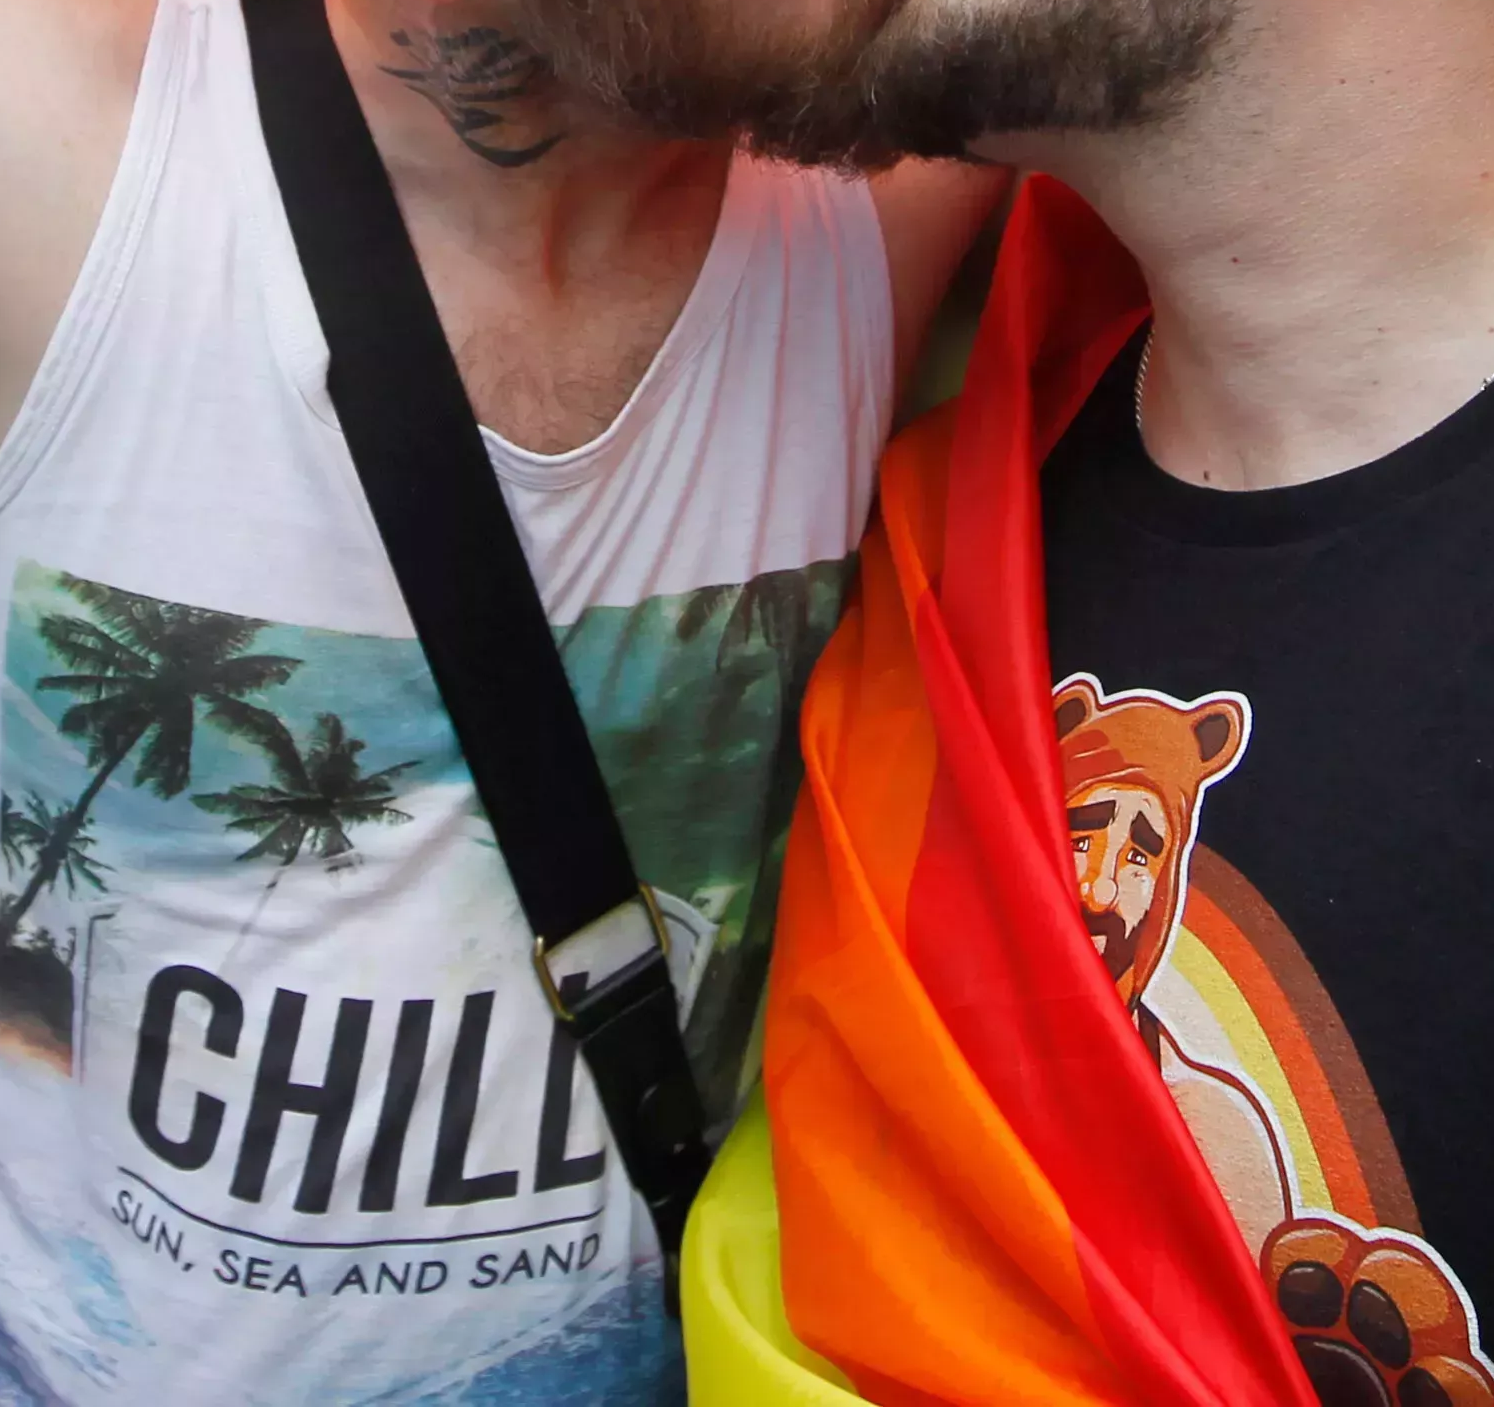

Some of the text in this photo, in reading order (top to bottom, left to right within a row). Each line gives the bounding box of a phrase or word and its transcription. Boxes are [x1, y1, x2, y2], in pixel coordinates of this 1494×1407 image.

[128, 964, 606, 1215] CHILL
[112, 1191, 600, 1297] SUN, SEA AND SAND
